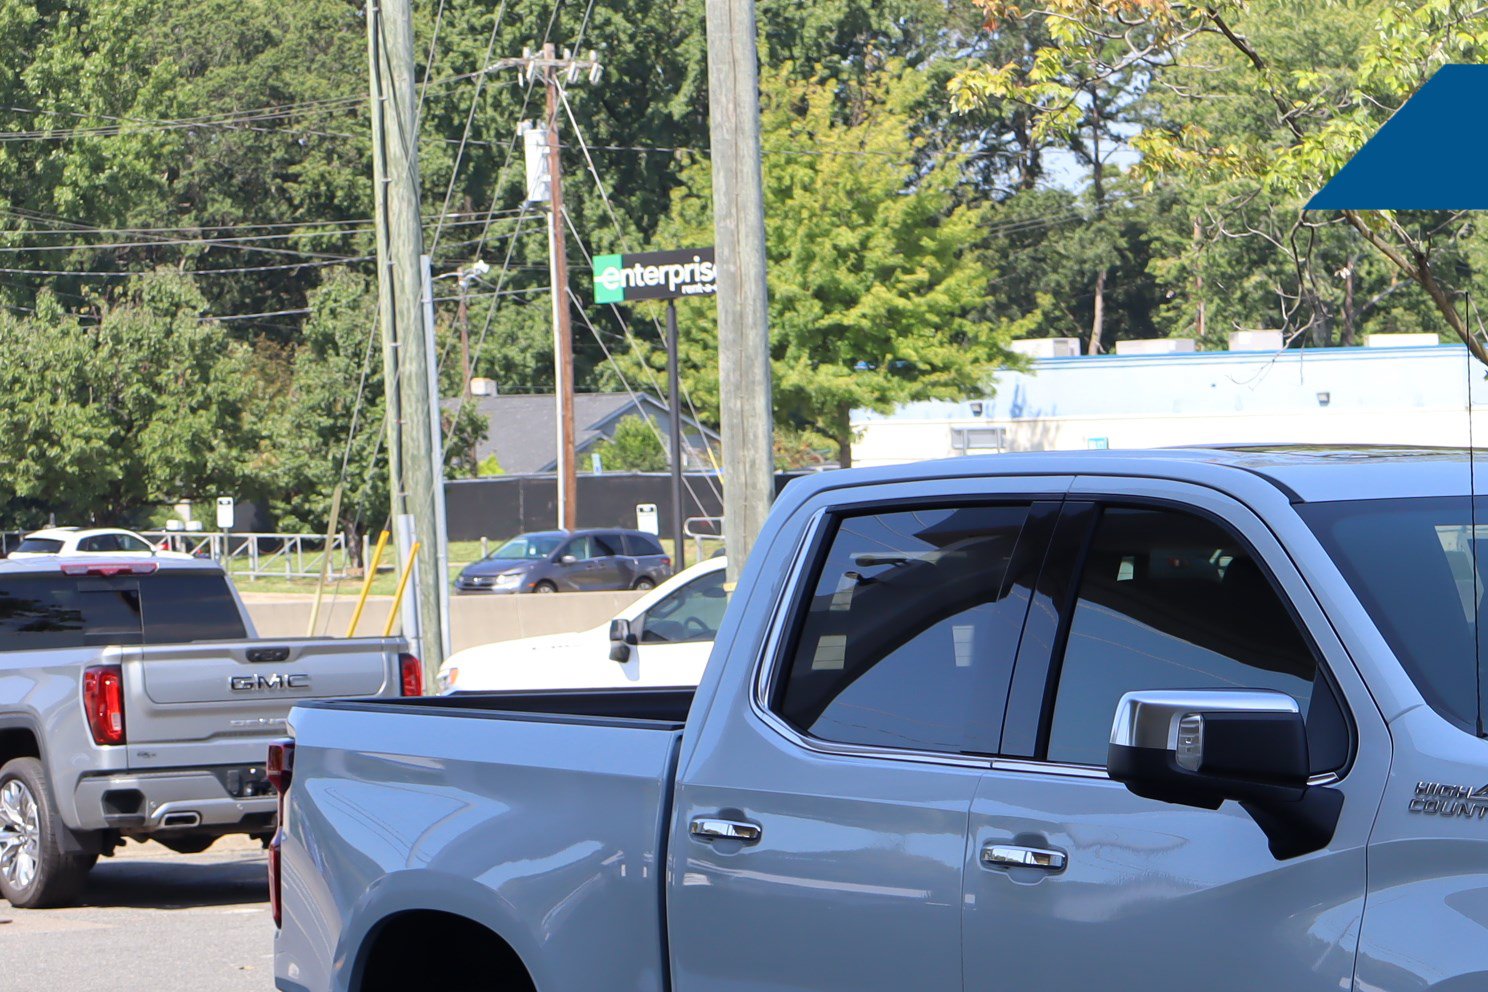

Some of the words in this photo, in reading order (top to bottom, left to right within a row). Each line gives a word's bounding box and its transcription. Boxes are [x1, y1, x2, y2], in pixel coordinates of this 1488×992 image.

[598, 255, 717, 291] enterpris
[229, 674, 311, 691] GMC
[1415, 781, 1474, 799] HIGH
